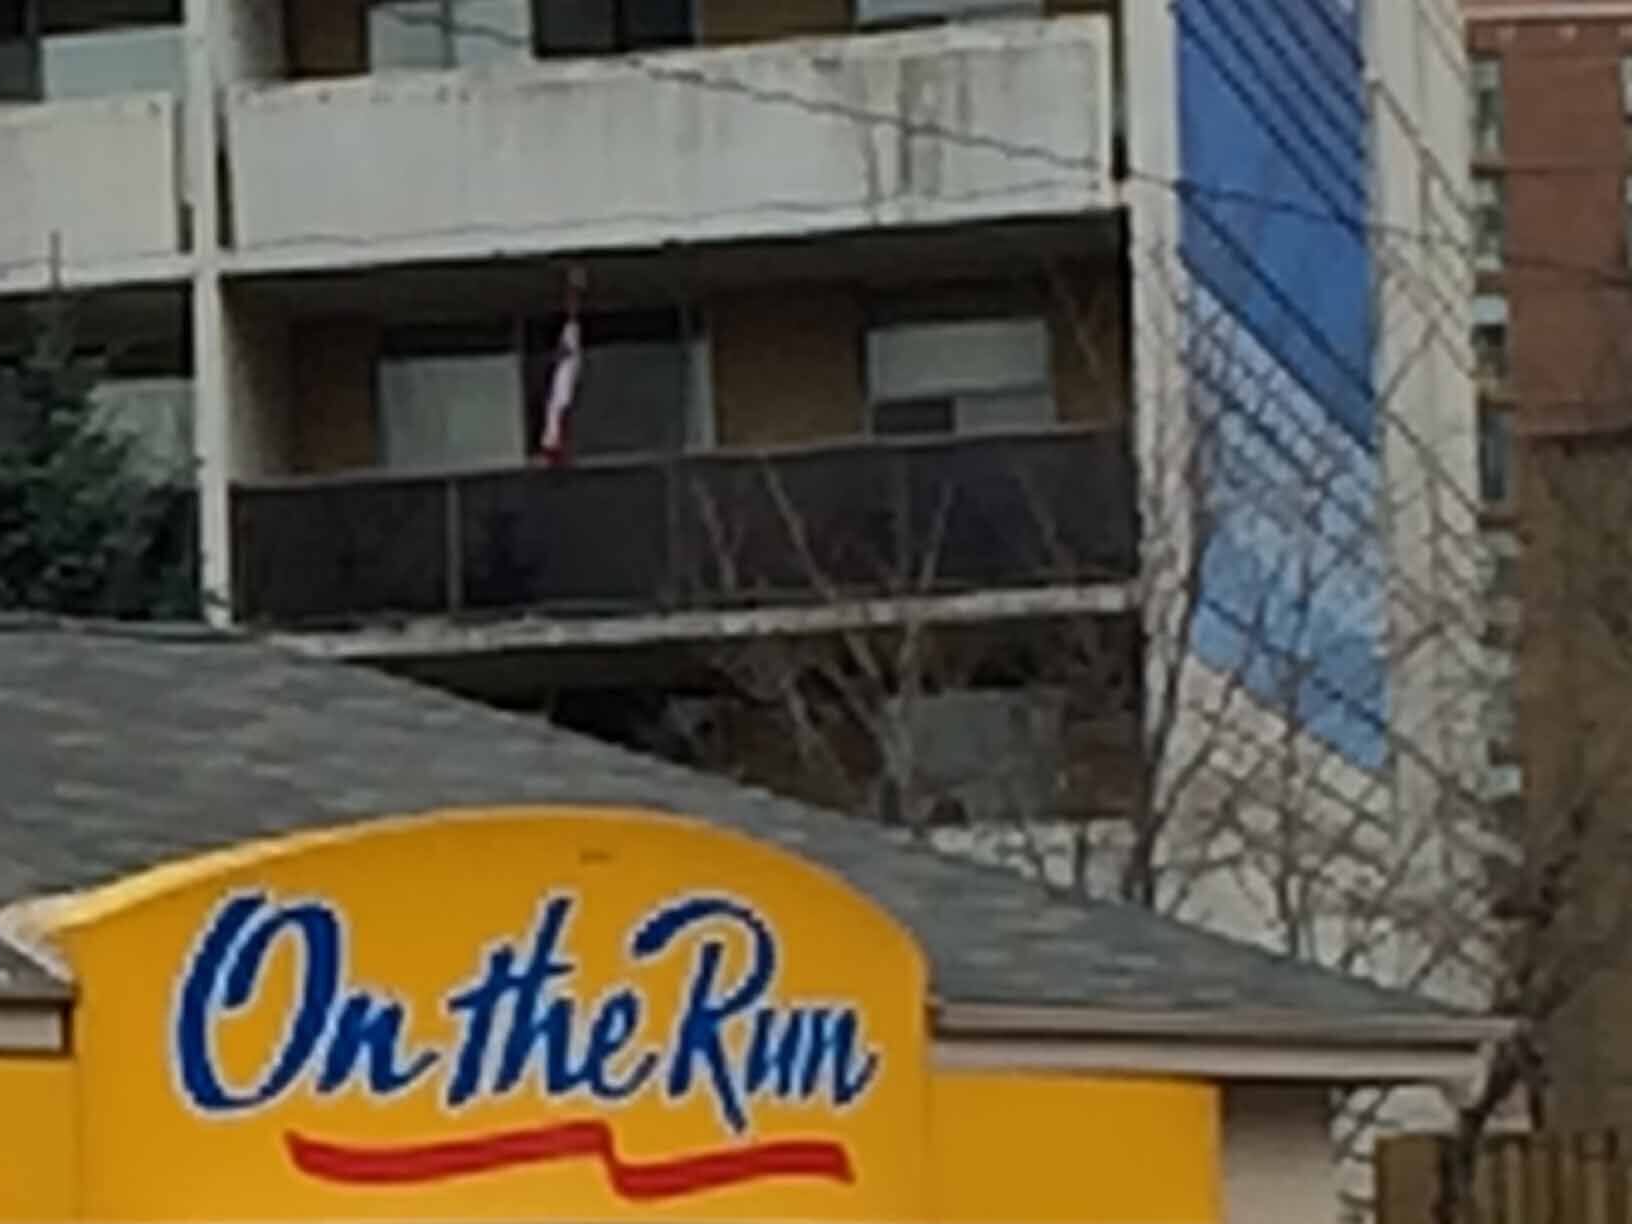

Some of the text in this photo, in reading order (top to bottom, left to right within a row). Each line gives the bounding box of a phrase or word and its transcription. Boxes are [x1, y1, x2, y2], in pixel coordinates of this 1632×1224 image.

[175, 890, 880, 1137] On the Run
